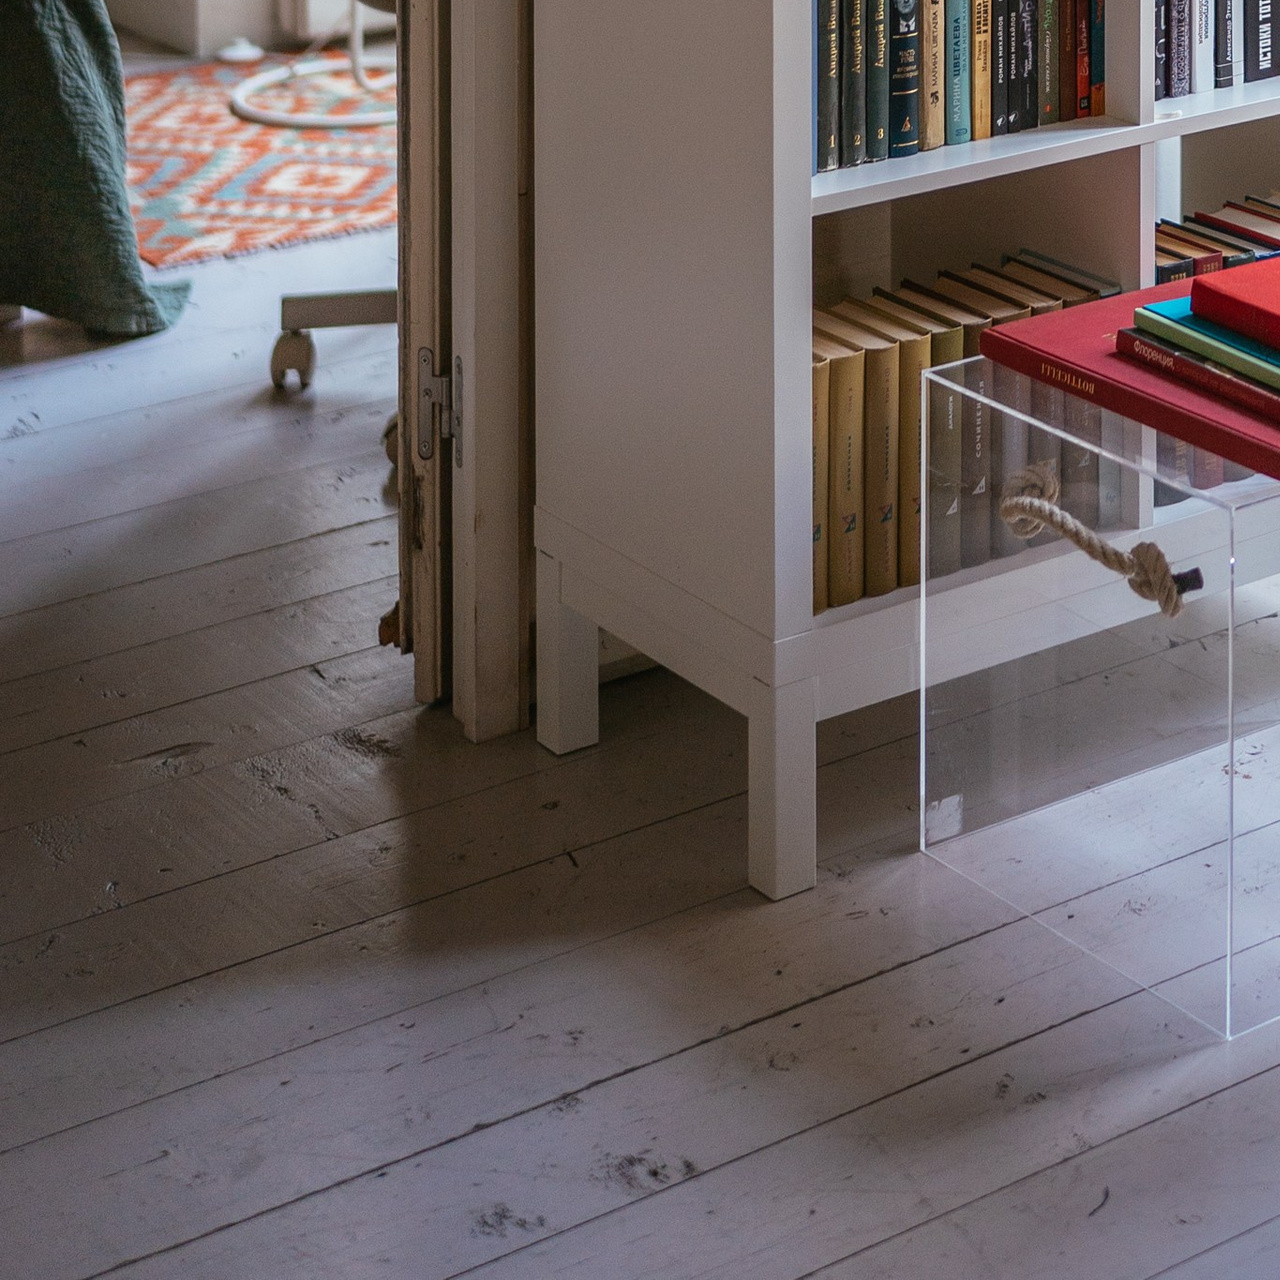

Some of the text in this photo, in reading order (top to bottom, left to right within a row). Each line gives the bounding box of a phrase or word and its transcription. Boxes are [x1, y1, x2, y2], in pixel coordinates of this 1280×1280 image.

[828, 33, 838, 78] Андрей
[852, 30, 863, 74] Андрей
[874, 23, 886, 68] Андрей
[931, 9, 939, 87] МАРИНА ЦВЕТАЕВА
[1259, 23, 1272, 70] ИСТОКИ
[829, 134, 836, 148] 1
[854, 134, 861, 146] 2
[877, 128, 885, 140] 3
[1040, 362, 1095, 395] BOTTICELLI
